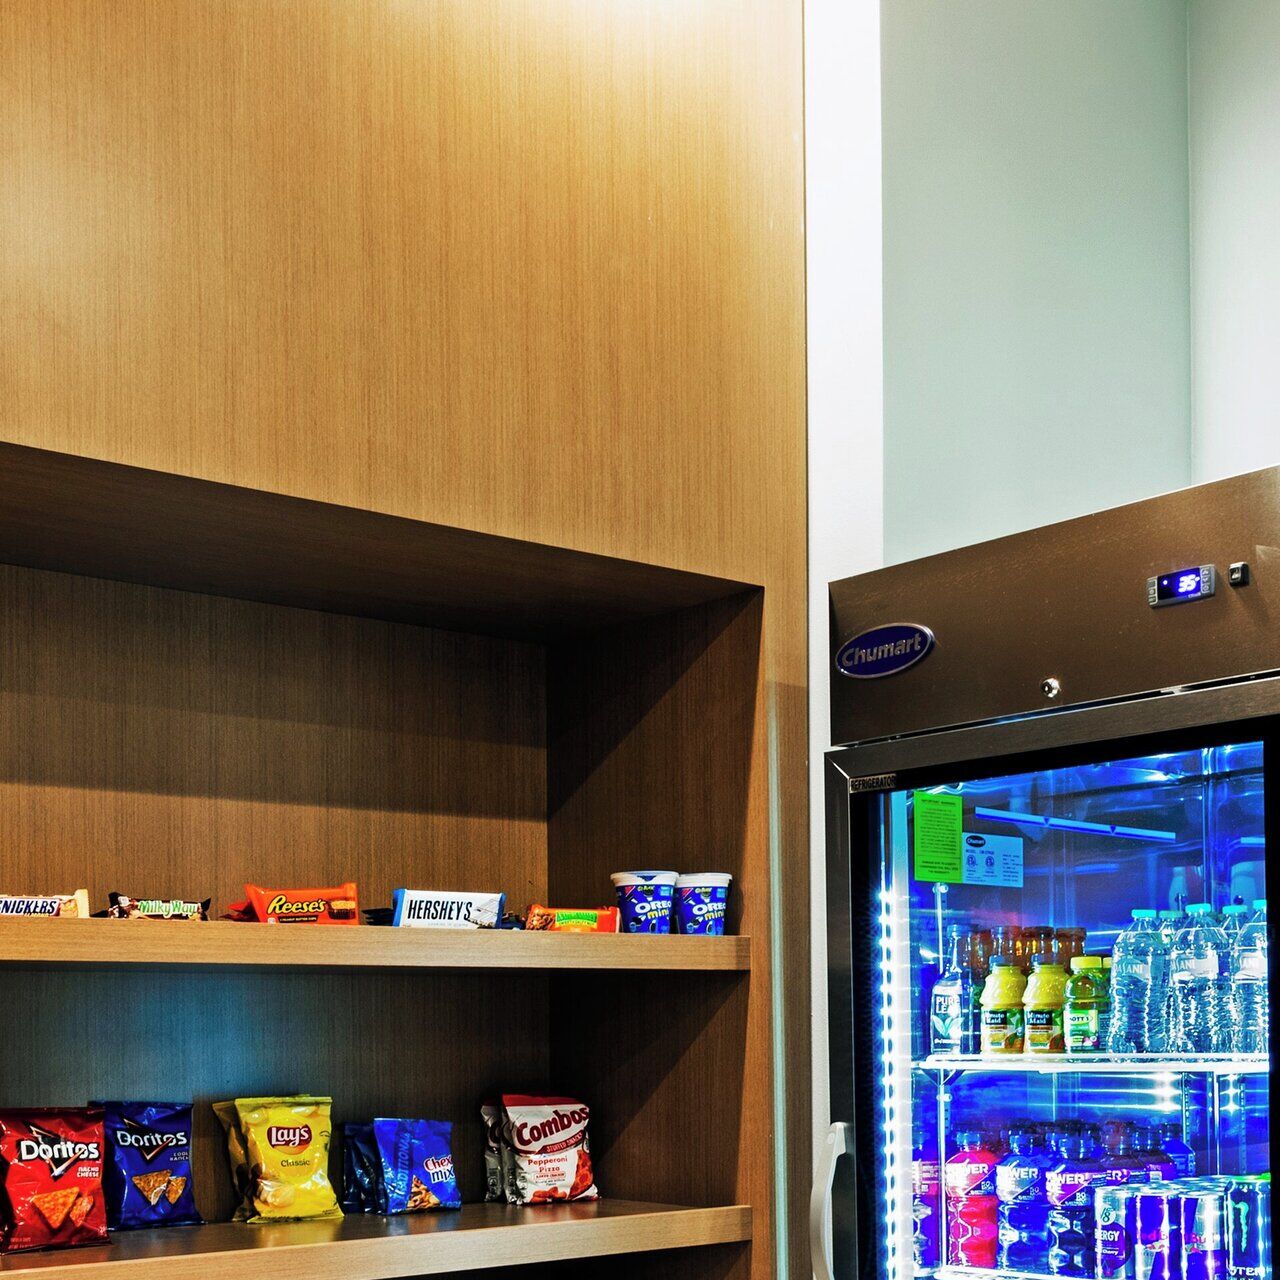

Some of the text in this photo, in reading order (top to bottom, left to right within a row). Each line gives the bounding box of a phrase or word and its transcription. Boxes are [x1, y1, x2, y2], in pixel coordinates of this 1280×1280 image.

[842, 632, 922, 667] Chumart
[138, 901, 198, 918] Milky Way
[267, 894, 326, 914] Reese's
[407, 900, 473, 921] HERSHEY'S
[516, 1106, 589, 1147] Combos
[117, 1131, 188, 1148] Doritos
[271, 1126, 309, 1146] Lay's
[21, 1140, 100, 1161] Doritos
[280, 1159, 311, 1168] Classic
[424, 1155, 453, 1171] Chex
[528, 1156, 568, 1167] Pepperoni
[431, 1168, 456, 1183] mix
